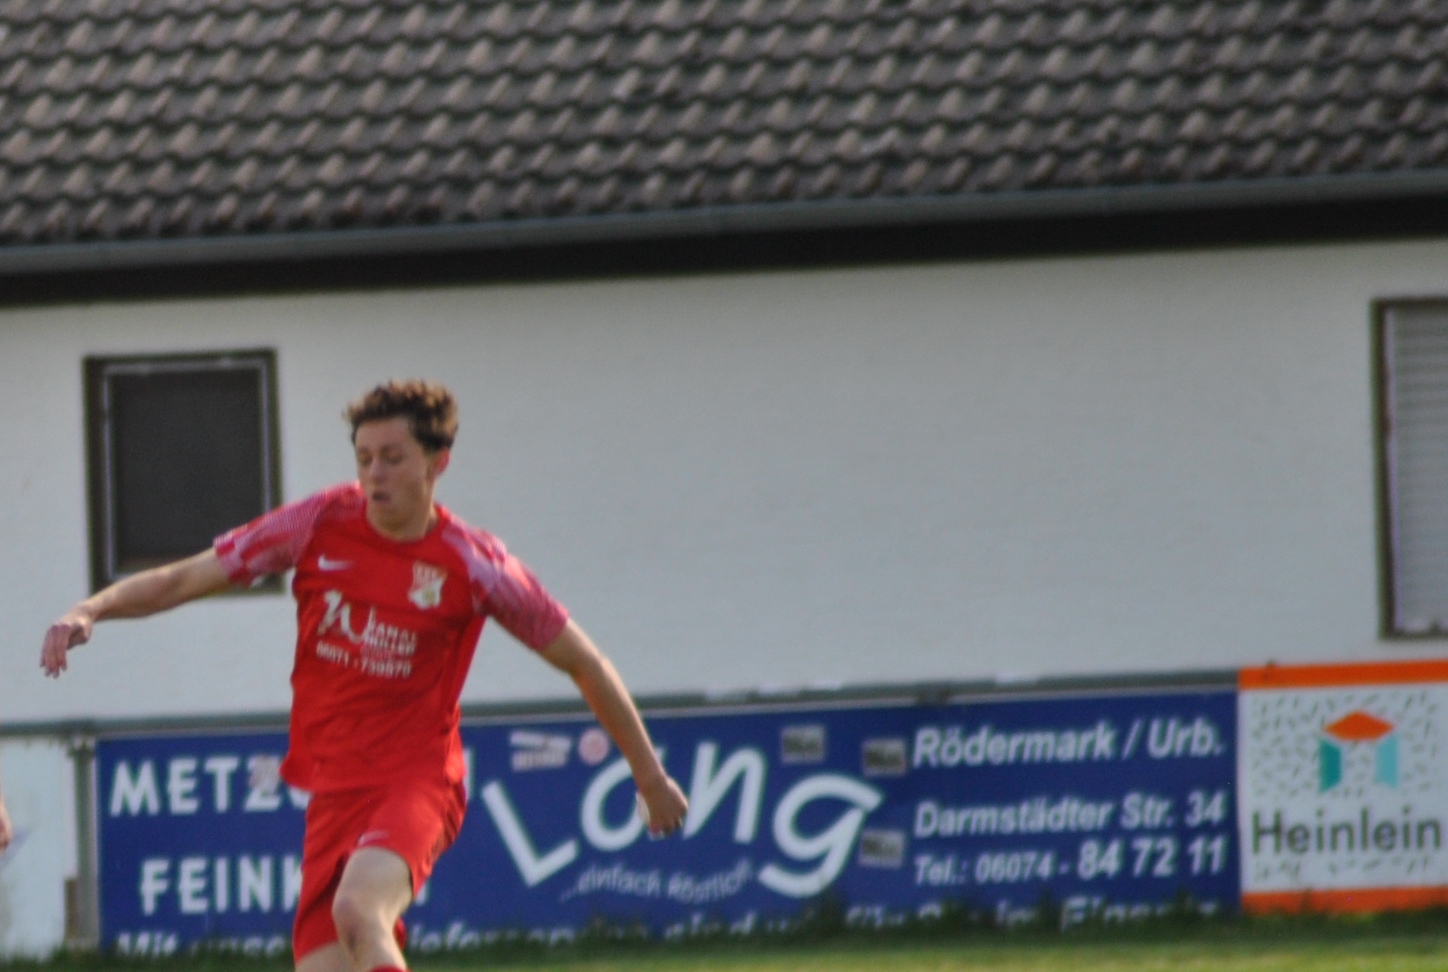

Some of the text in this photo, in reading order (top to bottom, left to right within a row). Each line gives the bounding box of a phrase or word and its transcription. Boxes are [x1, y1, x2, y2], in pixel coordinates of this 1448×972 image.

[913, 720, 1118, 768] Rödermark
[1148, 718, 1225, 758] Urb.
[481, 741, 883, 897] Lang
[914, 790, 1227, 838] Darmstädter Str. 34
[1253, 805, 1441, 854] Heinlein
[914, 854, 969, 885] Tel.:
[975, 852, 1054, 884] 06074
[1077, 839, 1122, 880] 84
[1132, 837, 1176, 878] 72
[1188, 835, 1227, 875] 11
